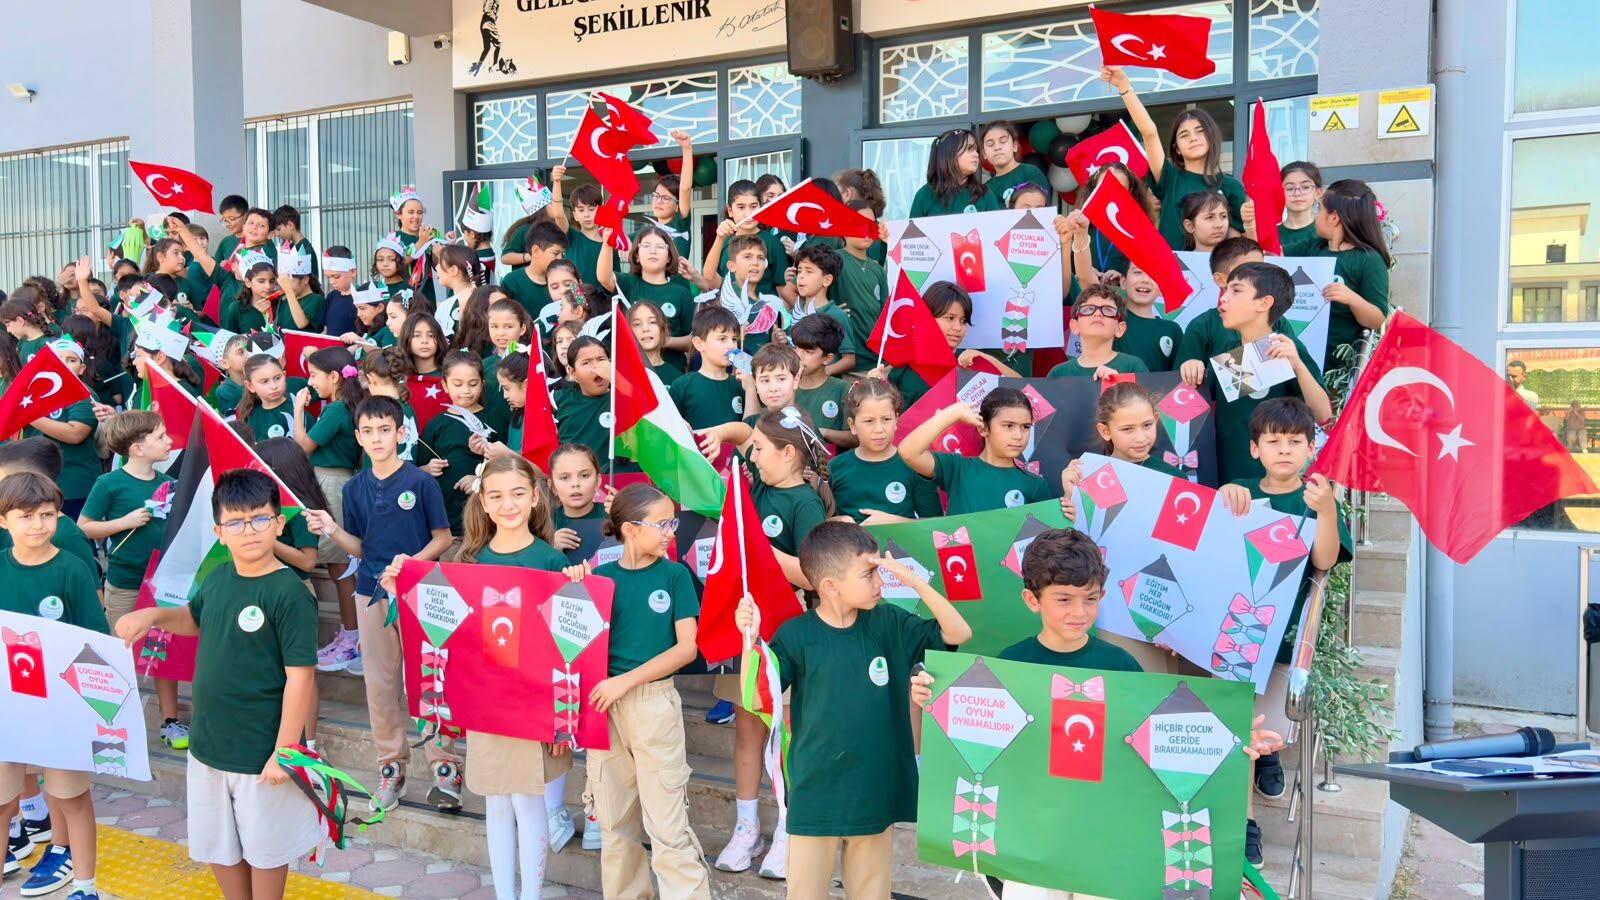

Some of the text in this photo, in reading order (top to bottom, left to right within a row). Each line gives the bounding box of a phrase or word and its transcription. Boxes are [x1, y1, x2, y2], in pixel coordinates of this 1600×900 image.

[1145, 578, 1169, 593] EĞİTİM
[426, 587, 449, 599] EĞİTİM
[1149, 588, 1162, 598] HER
[431, 597, 444, 605] HER
[560, 600, 584, 614] EĞİTİM
[424, 602, 455, 616] ÇOCUĞUN
[565, 610, 578, 619] HER
[1140, 602, 1173, 621] HAKKIDIR!
[427, 611, 458, 625] HAKKIDIR!
[558, 615, 588, 632] ÇOCUĞUN
[560, 624, 591, 641] HAKKIDIR!
[953, 694, 1006, 710] ÇOCUKLAR
[966, 706, 994, 719] OYUN
[952, 716, 1014, 733] OYNAMALIDIR!
[1155, 721, 1214, 735] HİÇBİR ÇOCUK
[1168, 734, 1201, 745] GERİDE
[1154, 745, 1223, 756] BIRAKILMAMALIDIR!
